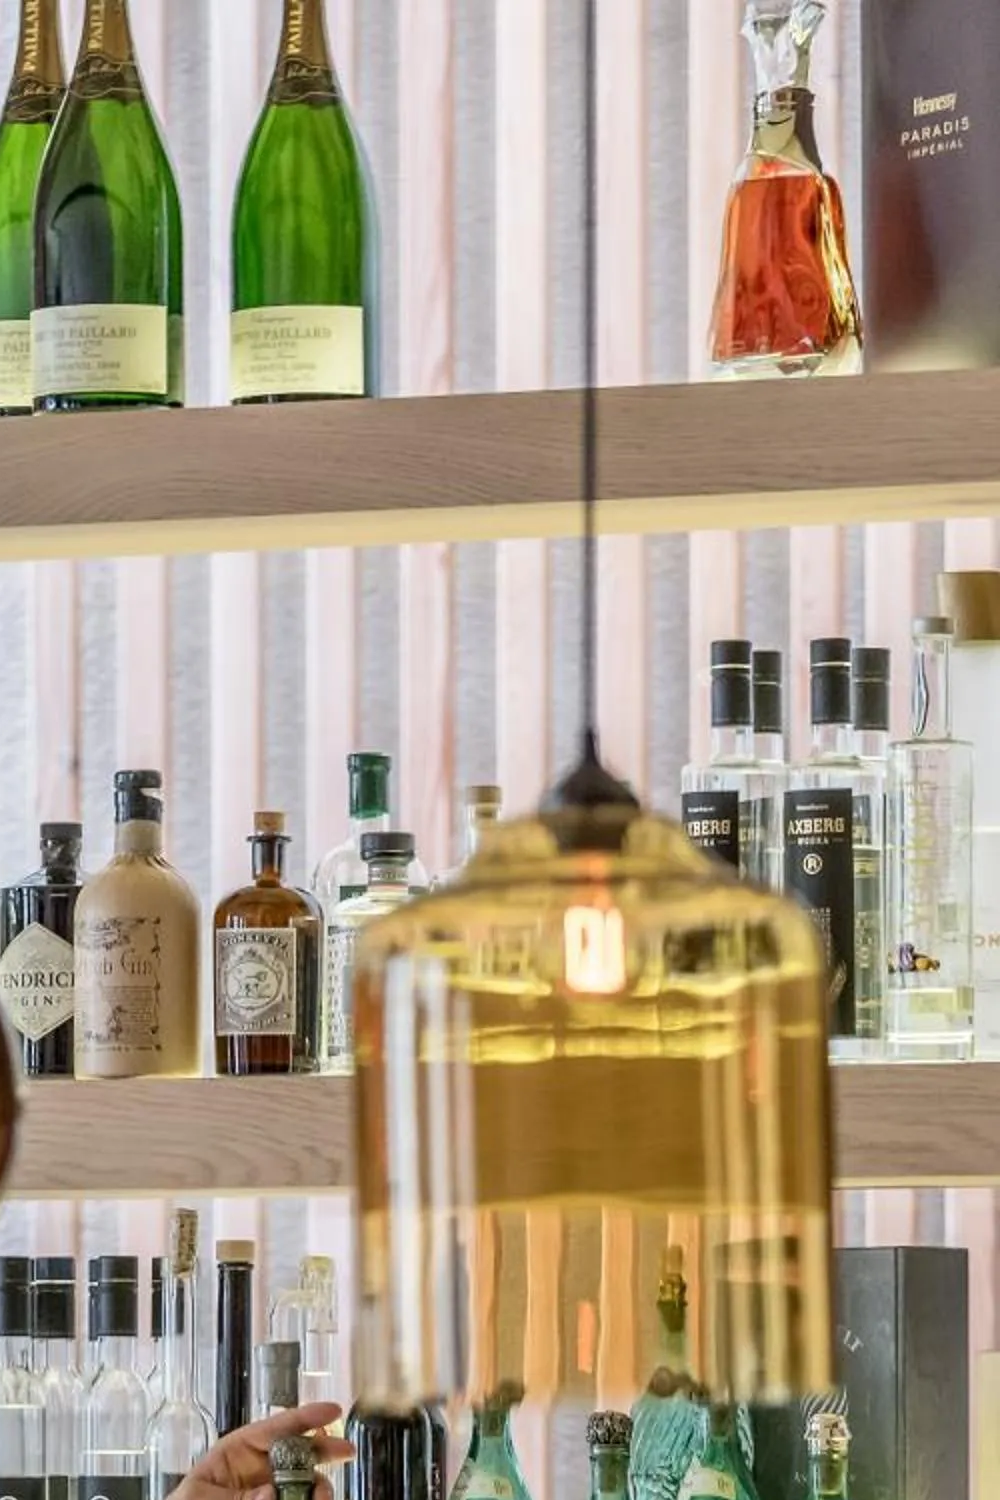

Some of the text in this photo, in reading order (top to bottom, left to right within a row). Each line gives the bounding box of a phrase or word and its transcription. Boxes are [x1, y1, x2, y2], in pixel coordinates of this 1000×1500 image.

[900, 116, 969, 147] PARADIS
[788, 817, 845, 836] AXBERG
[1, 971, 75, 990] ENDRIC
